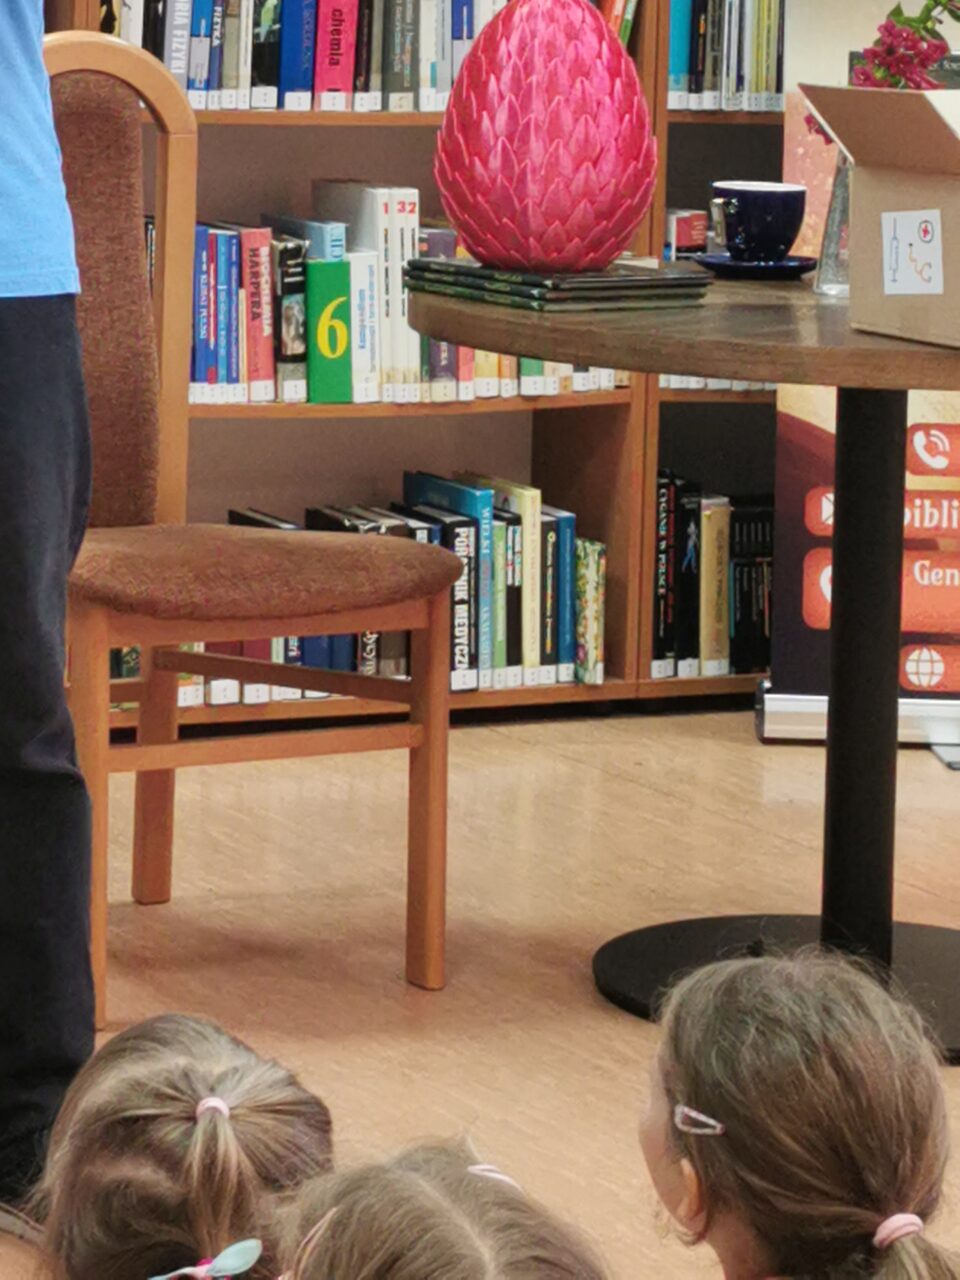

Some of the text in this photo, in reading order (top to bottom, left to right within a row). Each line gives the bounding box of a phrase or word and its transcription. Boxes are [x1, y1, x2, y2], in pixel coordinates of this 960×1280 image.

[211, 6, 223, 47] FIZYKA
[328, 8, 345, 67] chemia
[170, 29, 189, 74] FIZYKI
[382, 201, 389, 215] 1
[397, 201, 406, 214] 3
[408, 201, 416, 214] 2
[248, 248, 262, 321] HARPERA
[317, 296, 348, 359] 6
[913, 560, 960, 587] Gen
